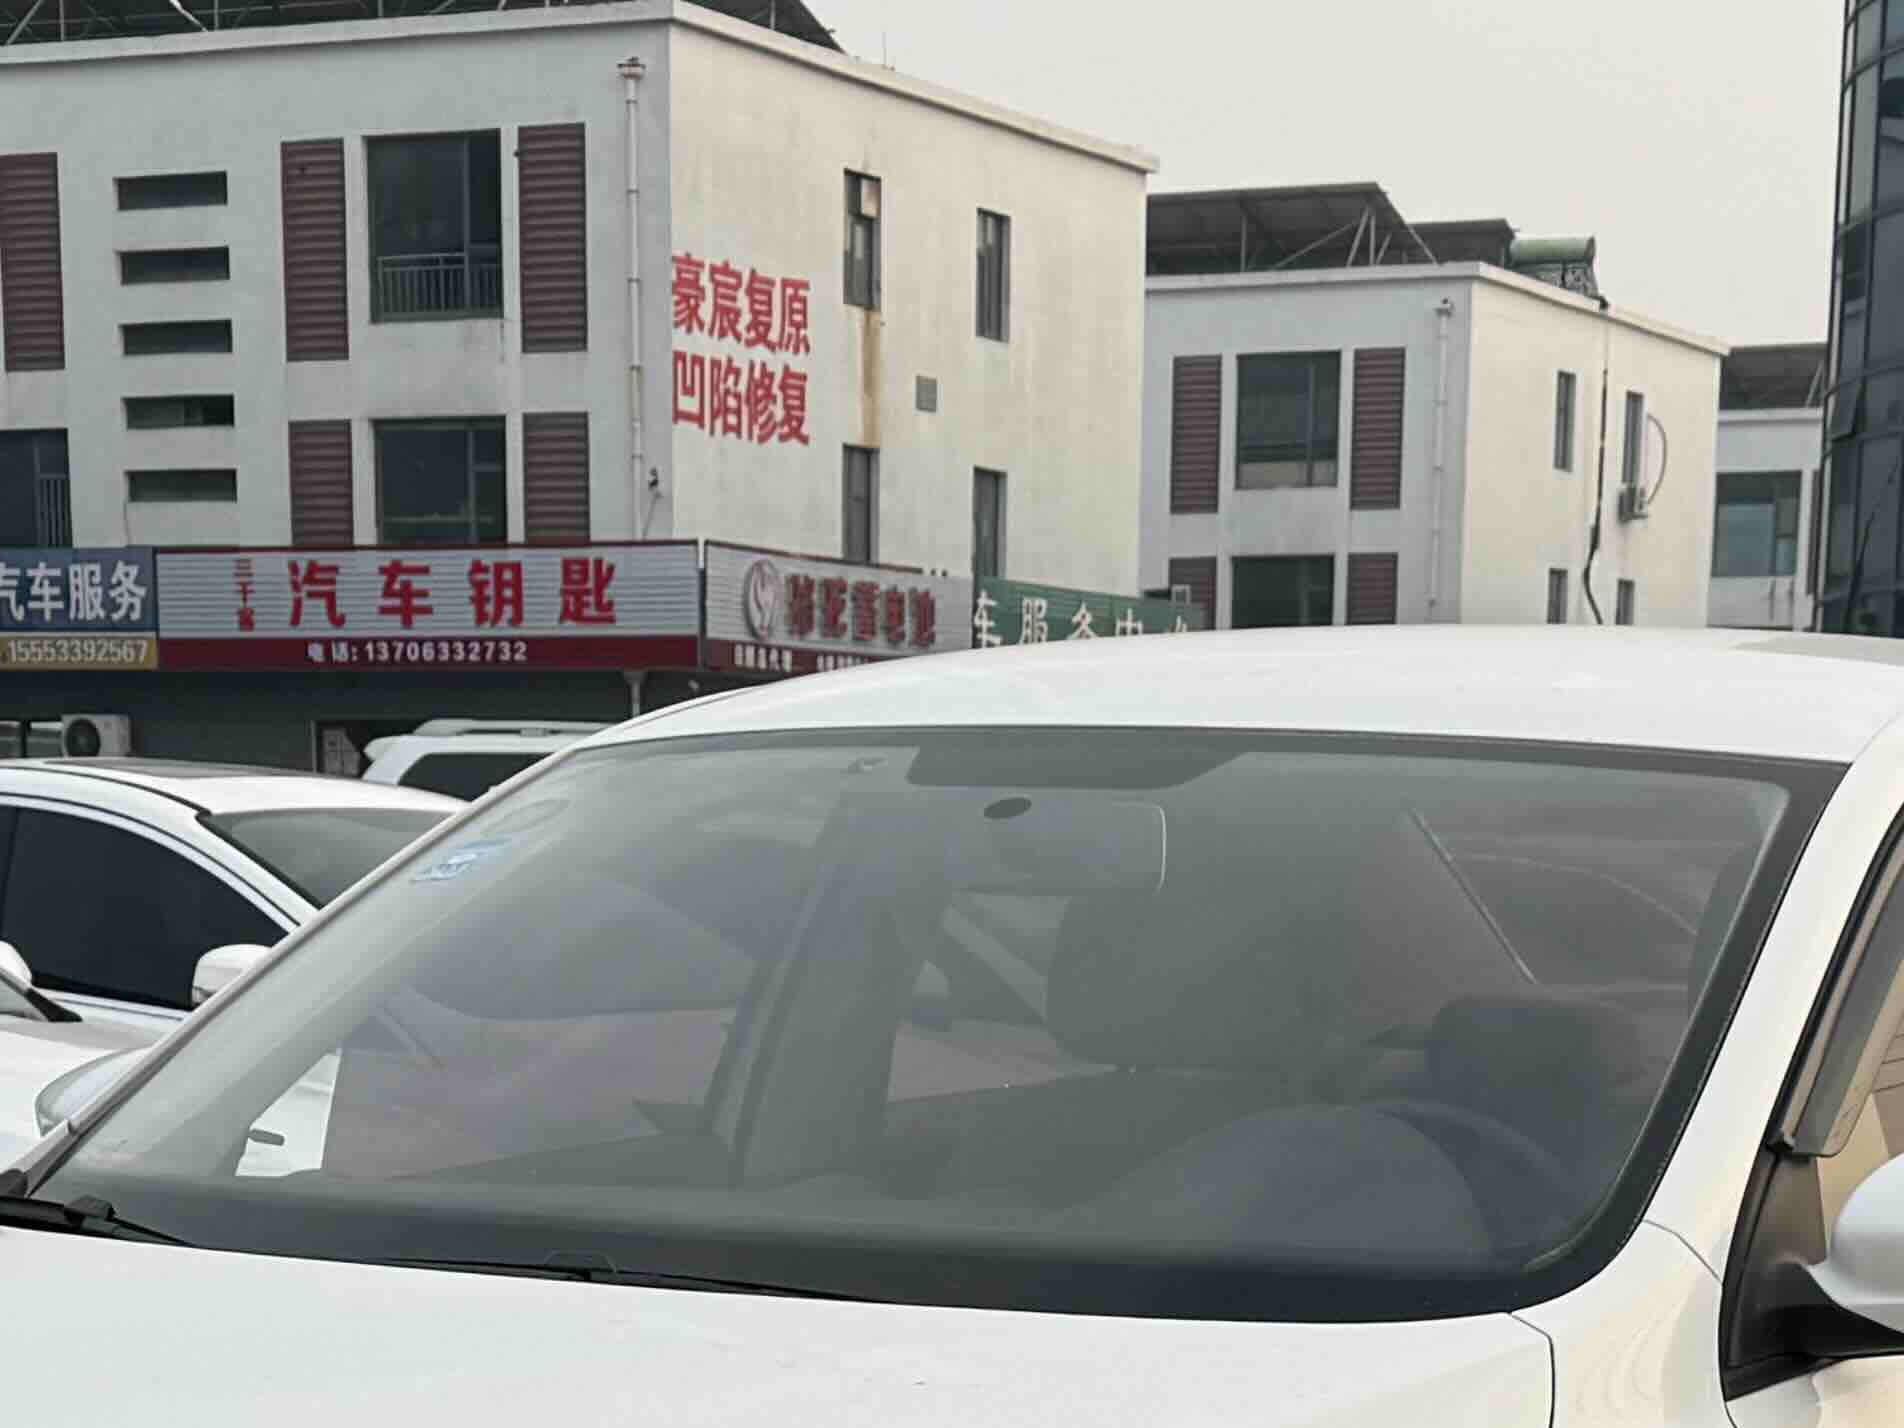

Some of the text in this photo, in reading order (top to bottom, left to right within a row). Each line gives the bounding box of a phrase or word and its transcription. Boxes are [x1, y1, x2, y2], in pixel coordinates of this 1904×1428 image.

[671, 251, 811, 356] 豪宸复原
[671, 349, 810, 447] 凹陷修复
[288, 557, 618, 628] 汽车钥匙
[7, 639, 147, 662] 15553392567
